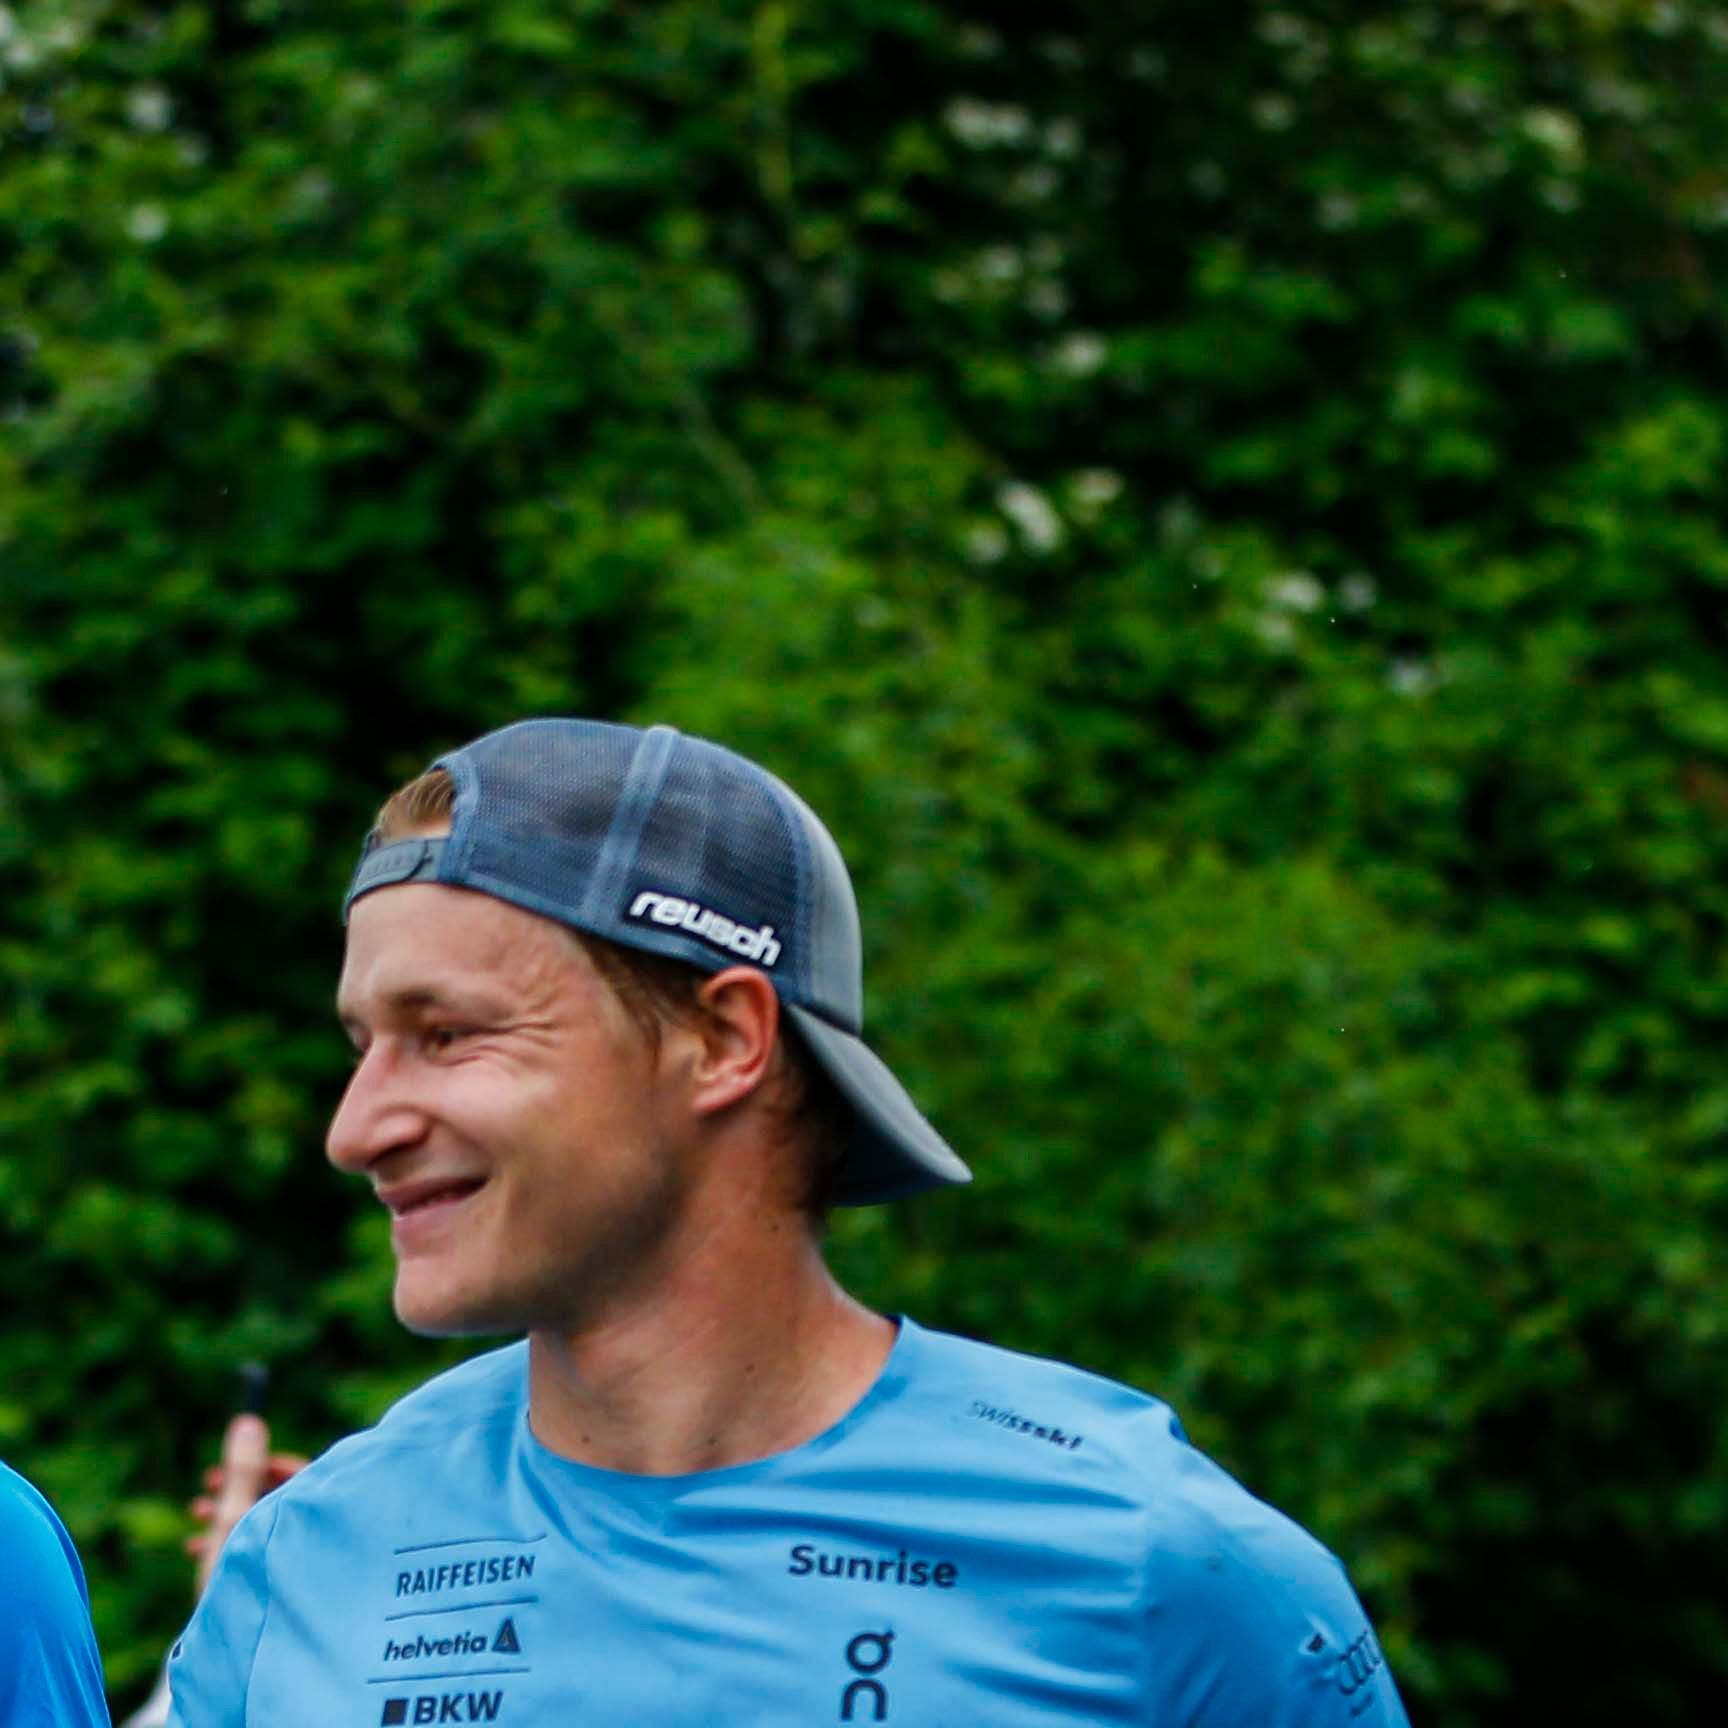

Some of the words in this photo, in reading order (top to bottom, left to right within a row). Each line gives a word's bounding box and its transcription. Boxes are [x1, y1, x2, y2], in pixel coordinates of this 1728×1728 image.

[629, 890, 782, 967] reusch
[395, 1553, 536, 1598] RAIFFEISEN
[788, 1544, 960, 1588] Sunrise
[383, 1628, 488, 1662] helvetia
[412, 1688, 504, 1726] BKW
